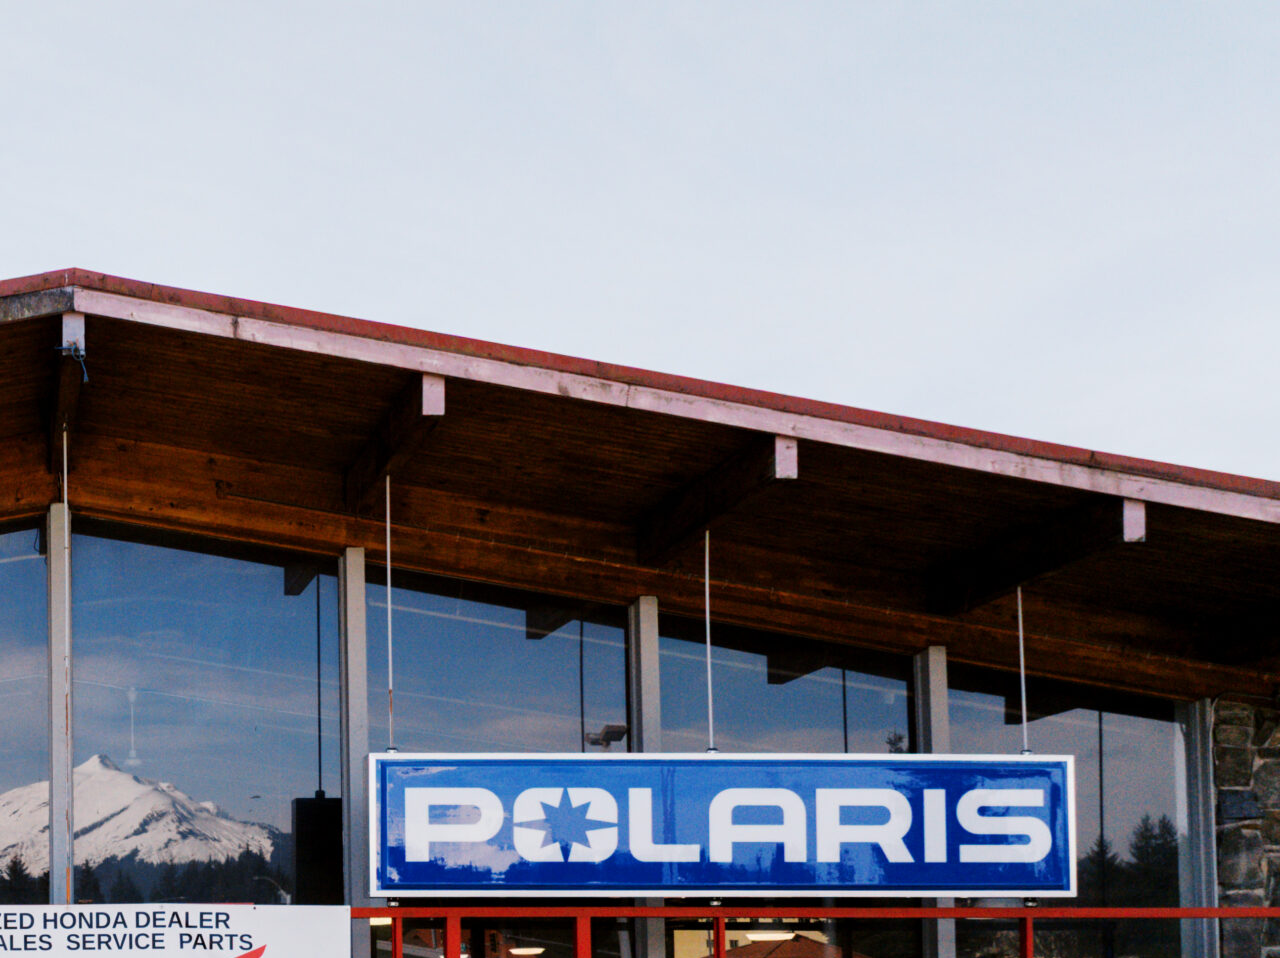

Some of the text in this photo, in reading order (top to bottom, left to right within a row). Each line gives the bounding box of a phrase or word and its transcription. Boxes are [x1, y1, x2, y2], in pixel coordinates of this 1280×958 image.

[404, 786, 1052, 863] POLARIS
[43, 911, 128, 929] HONDA
[135, 911, 230, 929] DEALER
[67, 933, 165, 951] SERVICE
[179, 933, 254, 950] PARTS
